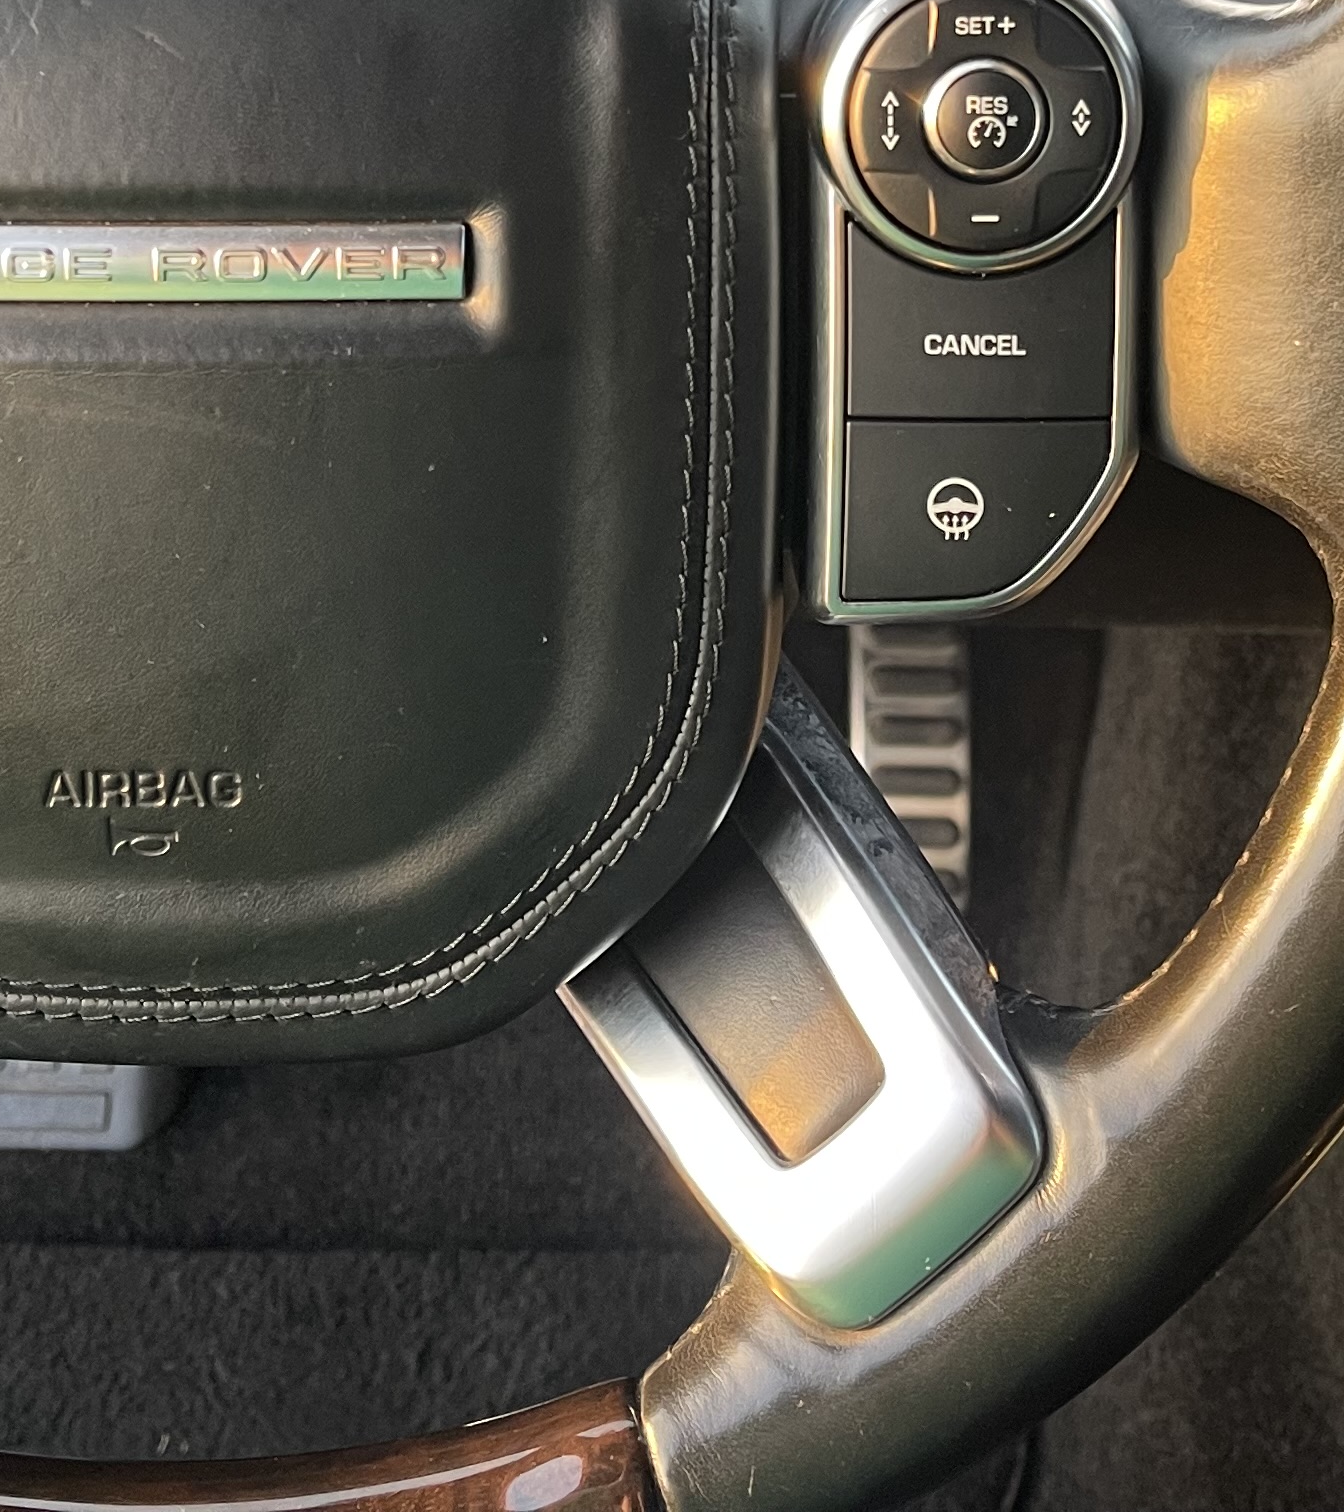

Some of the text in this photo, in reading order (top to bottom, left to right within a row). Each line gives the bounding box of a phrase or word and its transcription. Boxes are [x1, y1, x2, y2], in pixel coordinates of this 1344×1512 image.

[966, 96, 1008, 115] RES
[151, 244, 447, 284] ROVER
[924, 335, 1026, 357] CANCEL
[46, 770, 243, 809] AIRBAG
